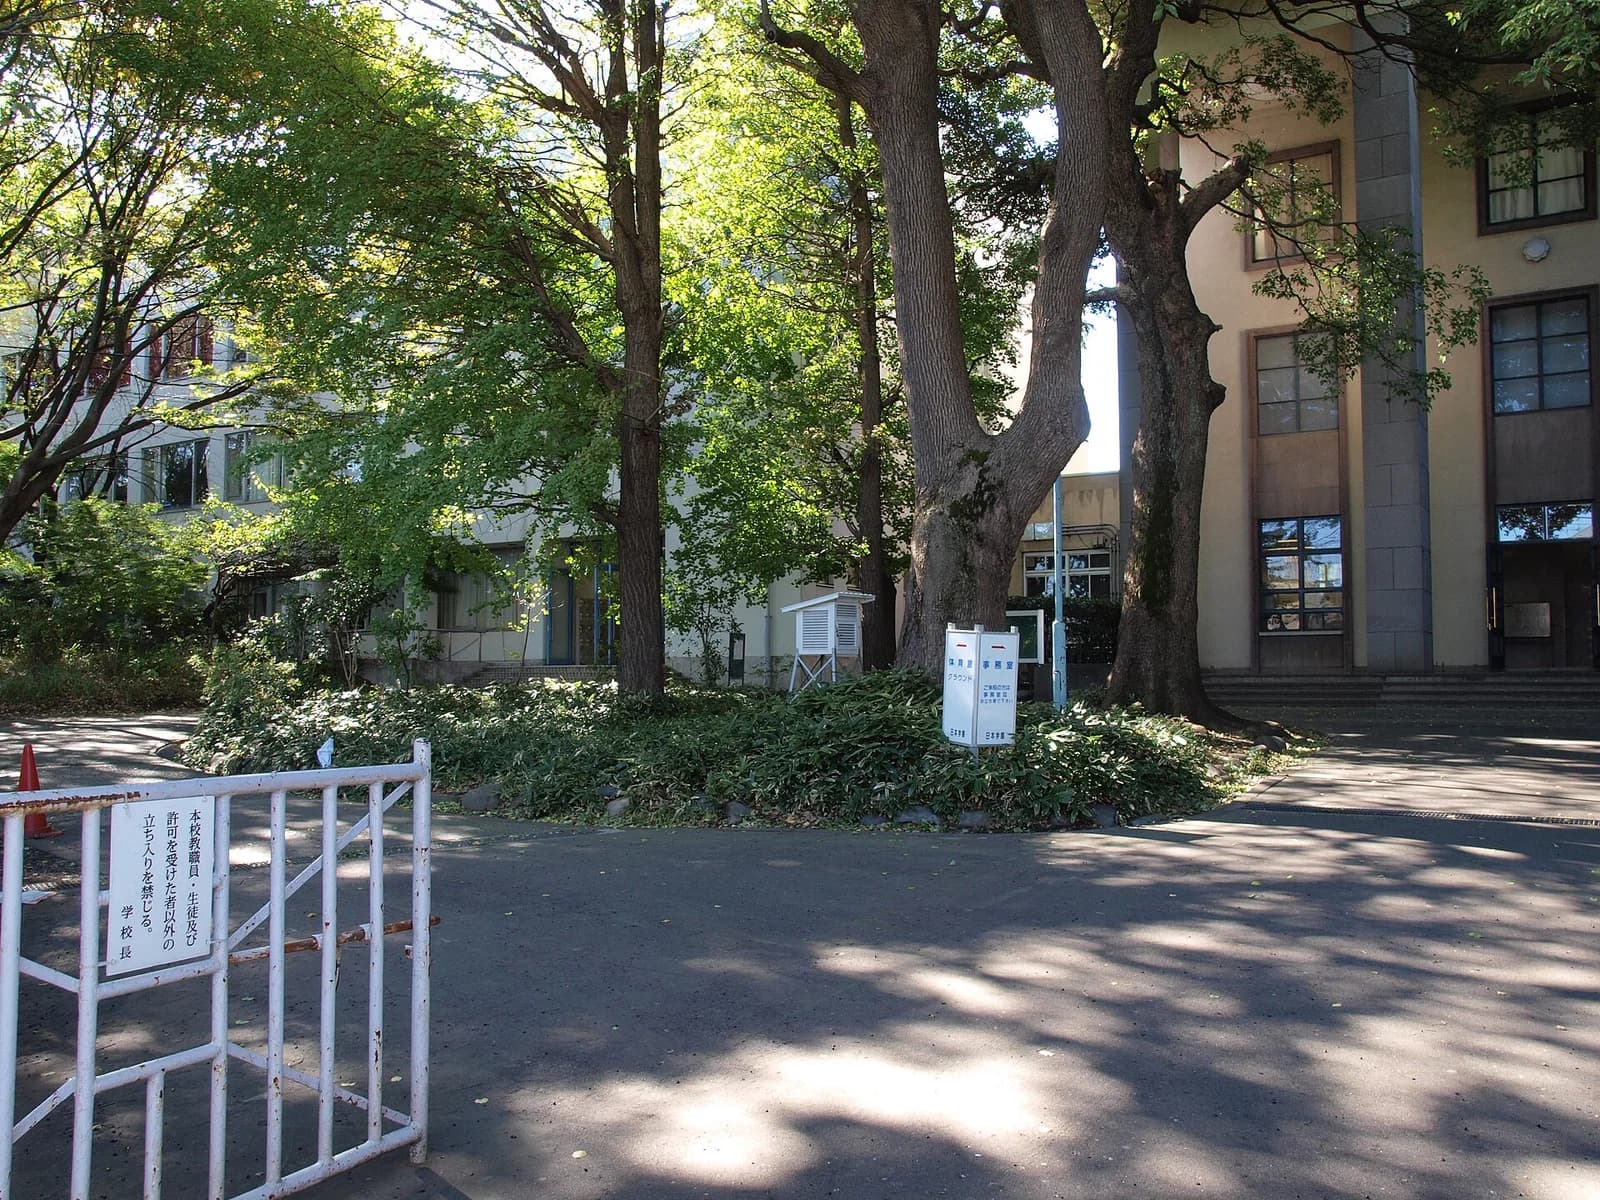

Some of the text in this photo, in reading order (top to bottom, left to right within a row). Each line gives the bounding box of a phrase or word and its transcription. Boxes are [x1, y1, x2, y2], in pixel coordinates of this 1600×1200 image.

[120, 905, 134, 959] 学校長
[141, 814, 156, 934] 立ち入りを禁じる。
[163, 811, 179, 951] 許可を受けた者以外の
[186, 809, 201, 946] 本校教職員・生徒及び
